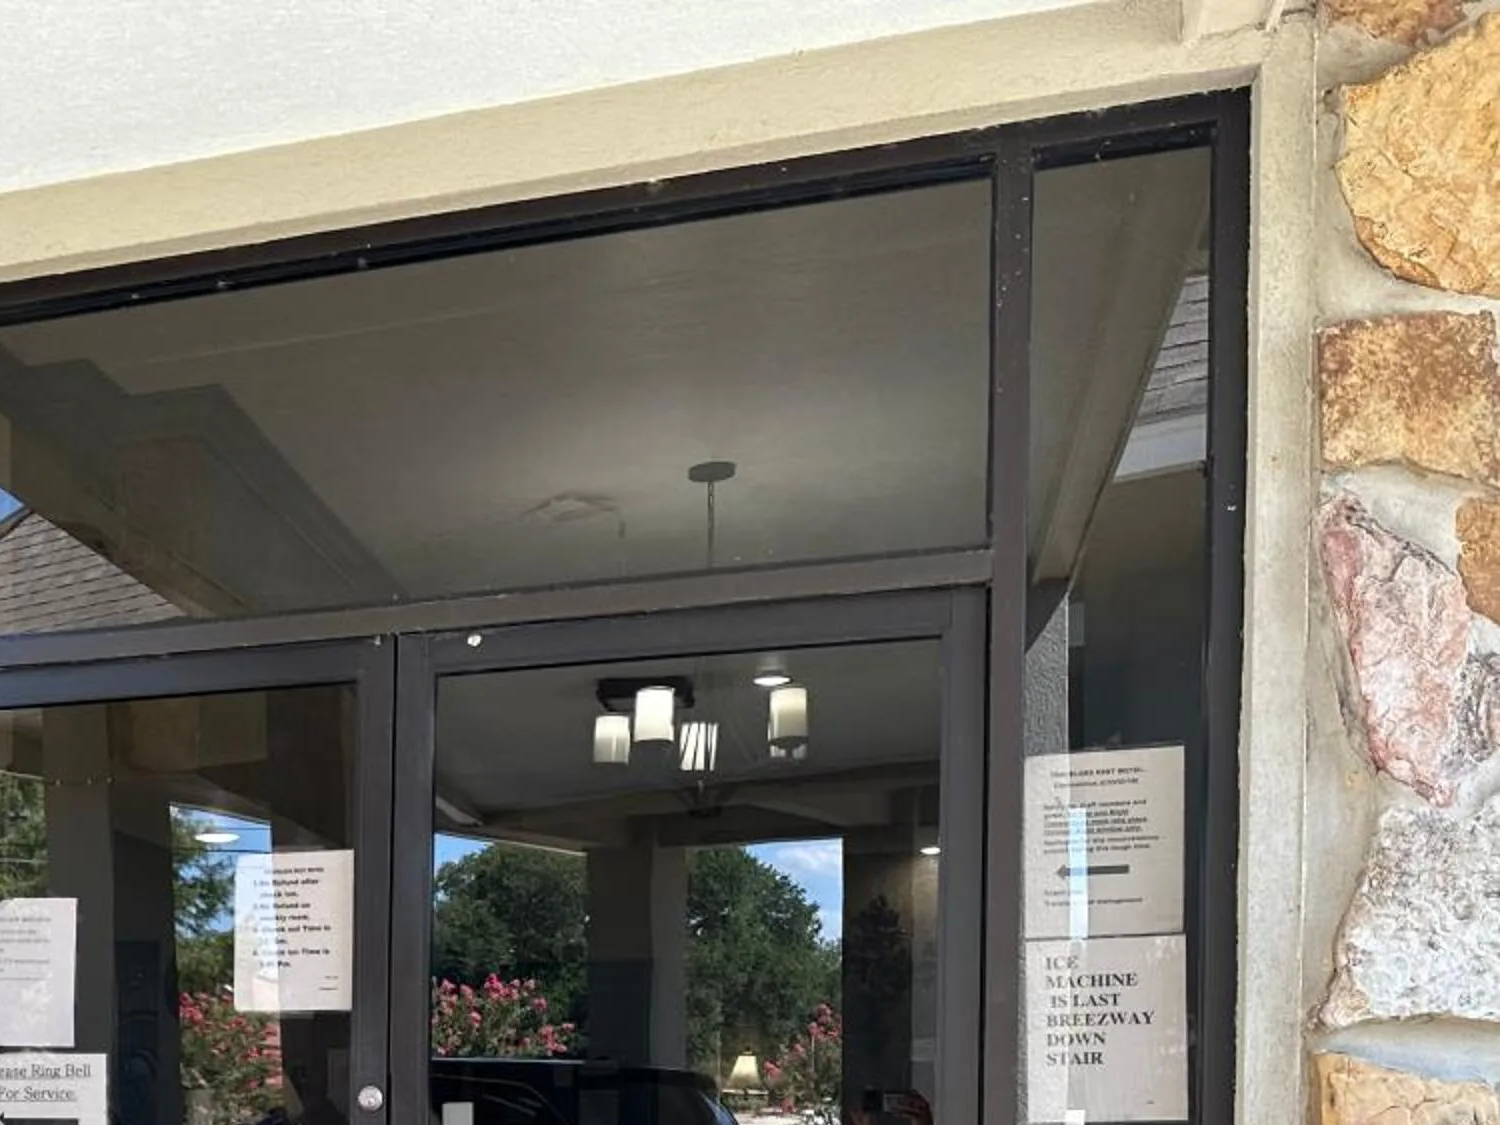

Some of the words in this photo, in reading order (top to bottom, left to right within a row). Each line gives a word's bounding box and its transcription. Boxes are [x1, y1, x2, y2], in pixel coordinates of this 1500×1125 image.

[1045, 956, 1079, 971] ICE
[1045, 972, 1139, 989] MACHINE
[1050, 994, 1068, 1008] IS
[1072, 993, 1121, 1007] LAST
[1046, 1011, 1155, 1028] BREEZWAY
[1046, 1031, 1106, 1047] DOWN
[1046, 1051, 1104, 1066] STAIR
[30, 1063, 61, 1080] Ring
[64, 1063, 92, 1079] Bell
